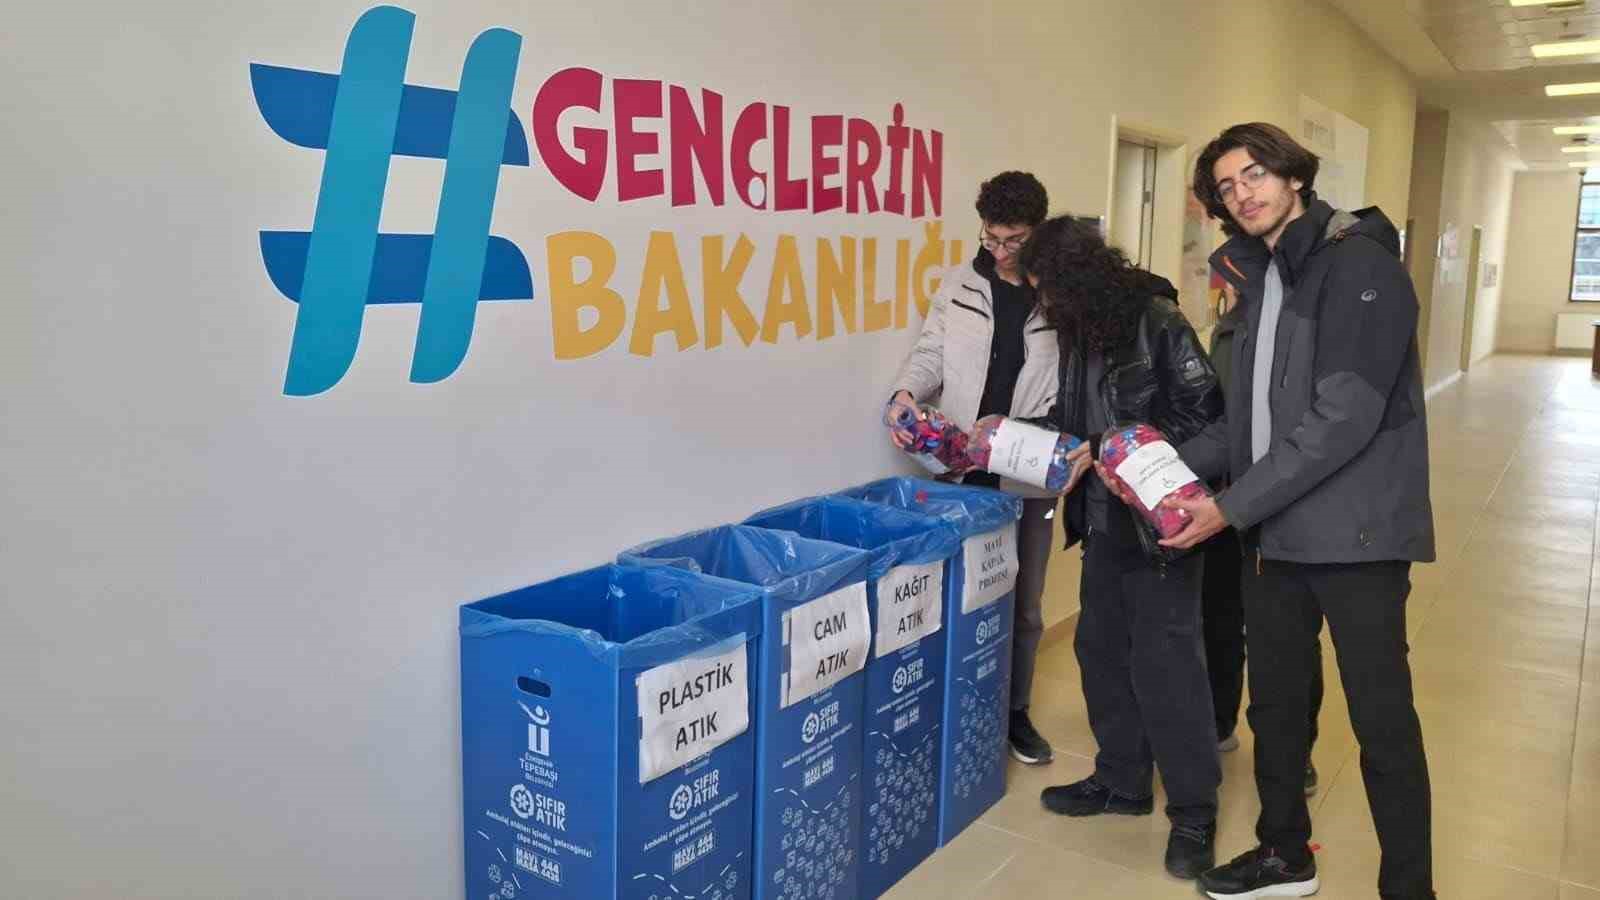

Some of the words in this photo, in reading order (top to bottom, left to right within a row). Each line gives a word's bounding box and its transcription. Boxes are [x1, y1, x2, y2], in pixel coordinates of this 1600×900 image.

[532, 66, 944, 219] GENÇLERİN
[545, 220, 963, 360] BAKANLIĞ
[894, 574, 930, 604] KAĞIT
[814, 611, 847, 641] CAM
[897, 608, 924, 635] ATIK
[815, 649, 849, 680] ATIK
[658, 663, 733, 715] PLASTİK
[675, 711, 718, 751] ATIK
[694, 769, 719, 791] SIFIR
[535, 793, 566, 817] SIFIR
[694, 783, 719, 808] ATIK
[536, 809, 566, 832] ATIK
